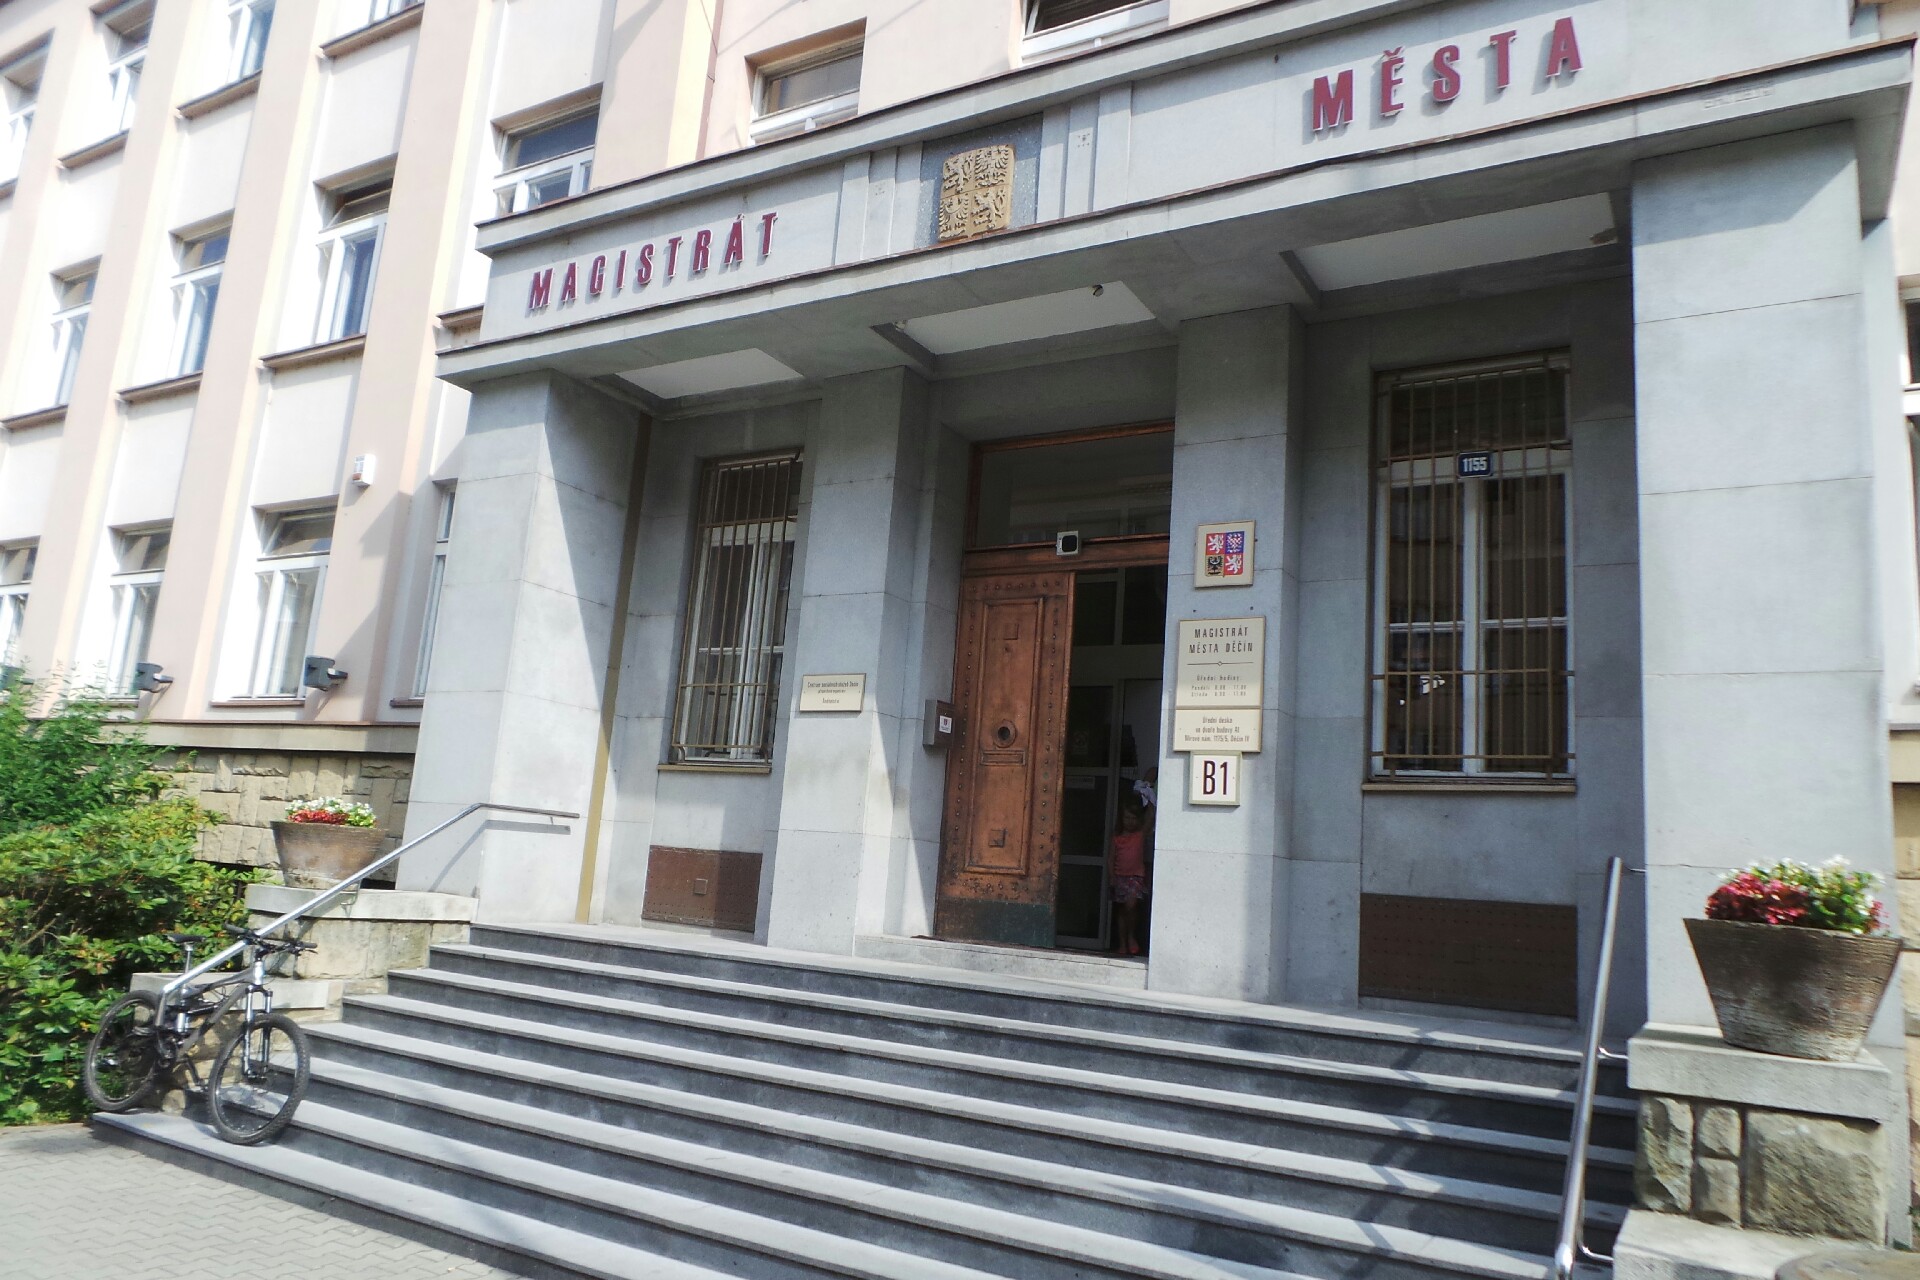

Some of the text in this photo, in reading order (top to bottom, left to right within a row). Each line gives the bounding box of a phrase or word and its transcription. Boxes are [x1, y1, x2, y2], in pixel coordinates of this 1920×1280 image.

[528, 16, 1584, 310] MAGISTRÁT MĚSTA
[1462, 457, 1488, 472] 1155
[1194, 625, 1248, 639] MAGISTRÁT
[1189, 640, 1253, 654] MĚSTA DĚČÍN
[1203, 760, 1228, 795] B1
